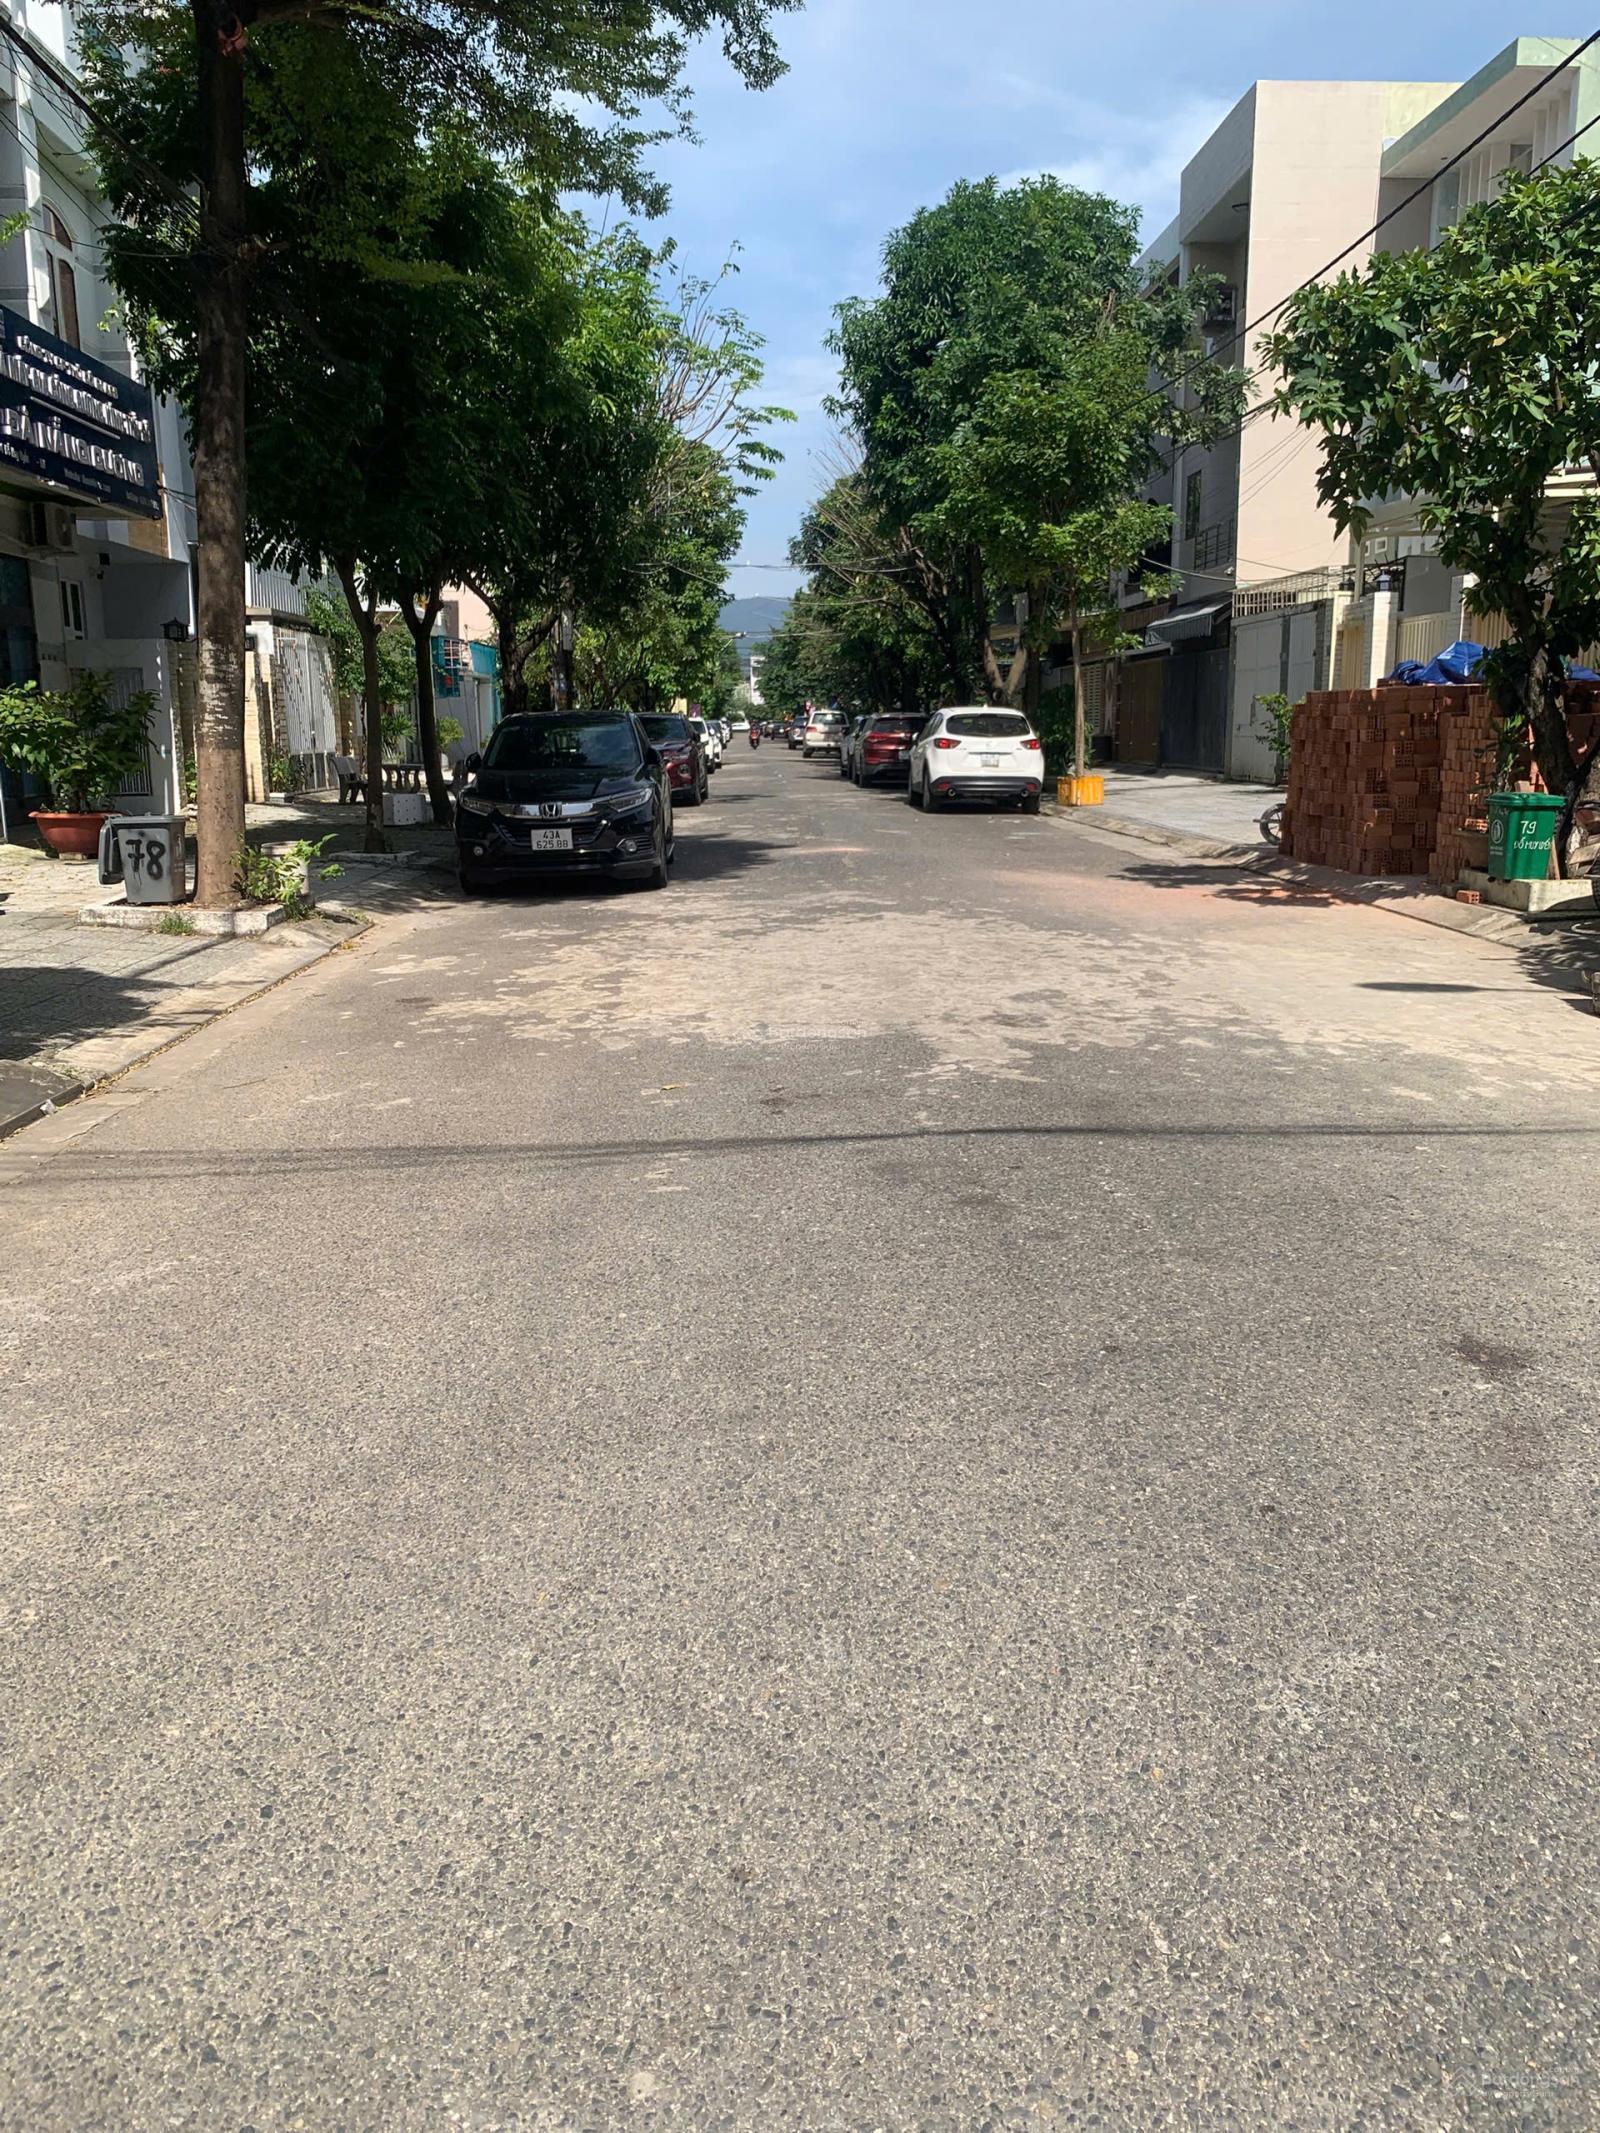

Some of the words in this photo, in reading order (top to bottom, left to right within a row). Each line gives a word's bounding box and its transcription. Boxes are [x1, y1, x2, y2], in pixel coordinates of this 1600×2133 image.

[1520, 821, 1537, 834] 79
[543, 830, 560, 840] 43A
[536, 839, 569, 849] 625.88
[126, 839, 166, 881] 78
